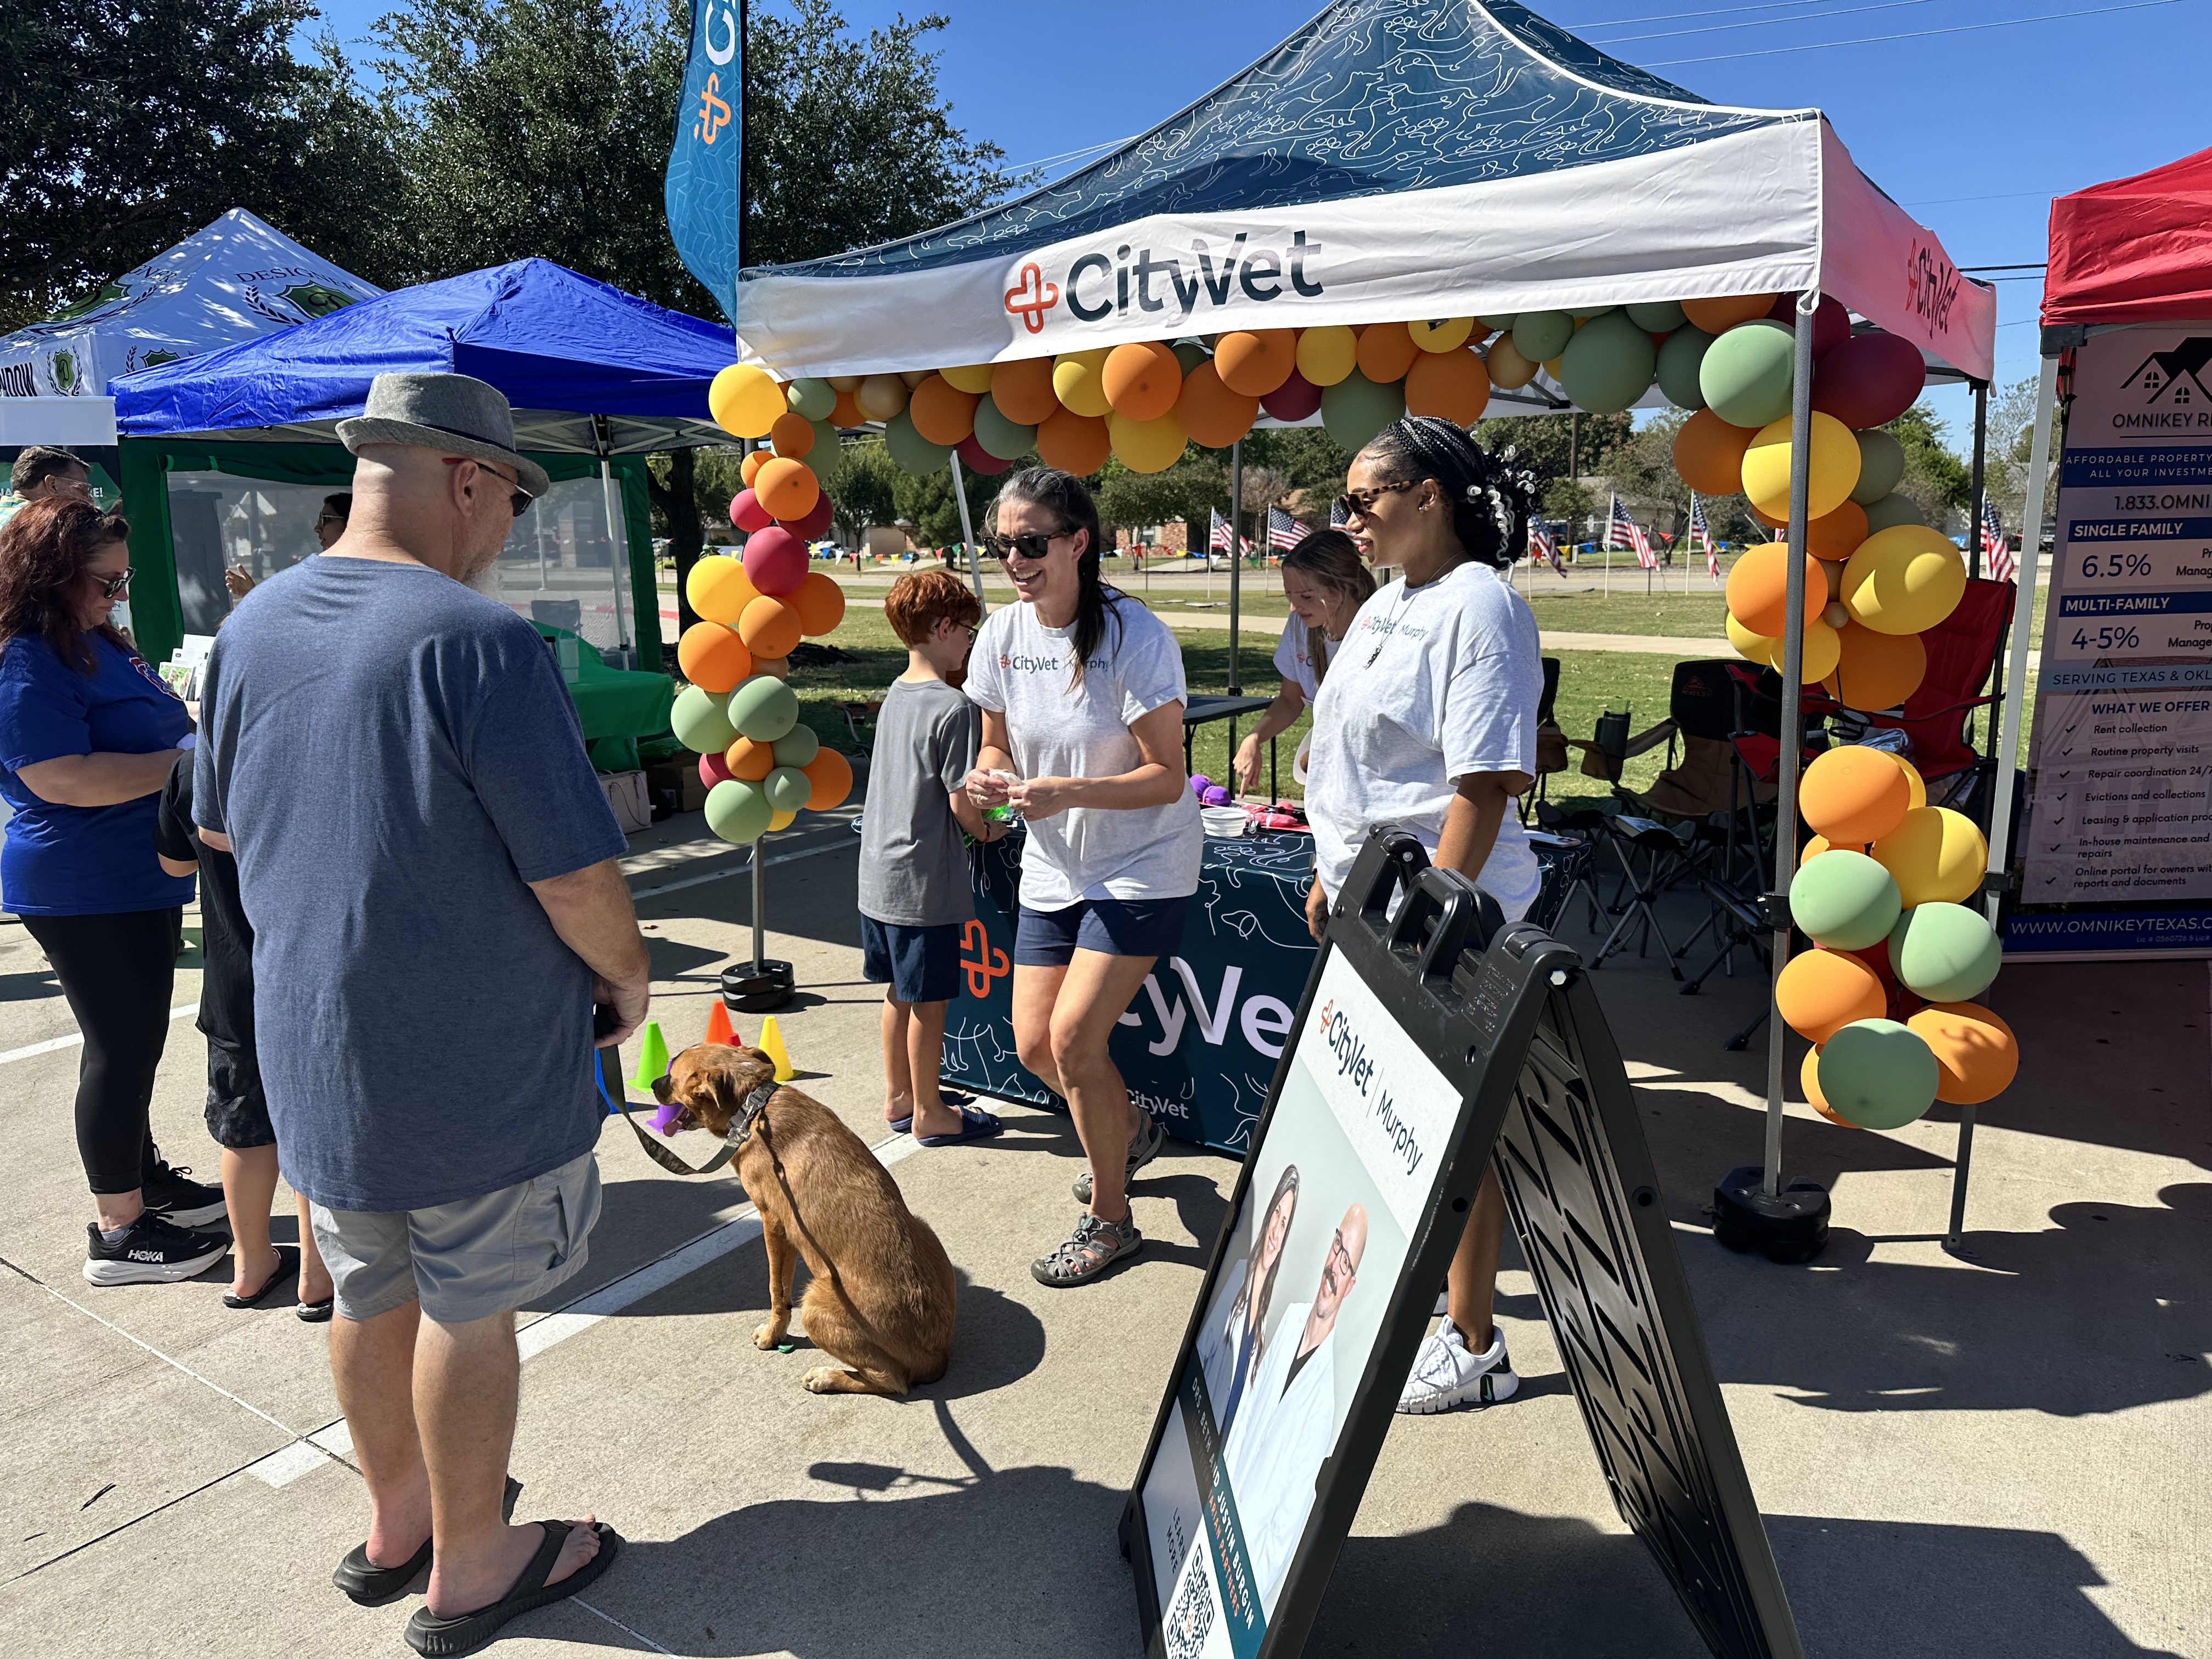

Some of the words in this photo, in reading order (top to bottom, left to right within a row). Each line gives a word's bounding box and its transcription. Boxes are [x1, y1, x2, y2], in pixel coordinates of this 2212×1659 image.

[1065, 230, 1324, 328] CityVet
[1917, 247, 1960, 340] CityVet
[2112, 413, 2193, 428] OMNIKEY
[2197, 413, 2212, 426] R
[2066, 454, 2145, 465] AFFORDABLE
[2089, 469, 2111, 478] ALL
[2117, 468, 2149, 477] YOUR
[2114, 494, 2212, 510] 1.833.OMNI
[2074, 523, 2126, 537] SINGLE
[2130, 522, 2183, 536] FAMILY
[2081, 552, 2152, 578] 6.5%
[2066, 596, 2170, 612] MULTI-FAMILY
[1401, 624, 1429, 641] Murphy
[2072, 625, 2140, 650] 4-5%
[1012, 655, 1059, 674] CityVet
[2053, 673, 2117, 685] SERVING
[2121, 671, 2165, 683] TEXAS
[2170, 670, 2179, 681] &
[2092, 702, 2135, 714] WHAT
[2140, 702, 2161, 713] WE
[2165, 701, 2210, 712] OFFER
[2094, 724, 2117, 734] Rent
[2119, 723, 2168, 733] collection
[2091, 747, 2128, 757] Routine
[2131, 746, 2174, 758] property
[2176, 744, 2199, 754] visits
[2088, 769, 2121, 780] Repair
[2123, 766, 2187, 778] coordination
[2085, 791, 2128, 802] Evictions
[2130, 790, 2151, 800] and
[2153, 789, 2206, 799] collections
[2083, 815, 2119, 827] Leasing
[2123, 815, 2130, 823] &
[2132, 812, 2189, 826] application
[2079, 837, 2121, 847] In-house
[2123, 835, 2188, 846] maintenance
[2191, 833, 2210, 843] and
[2078, 849, 2112, 860] repairs
[2075, 866, 2108, 876] Online
[2110, 865, 2141, 878] portal
[2143, 864, 2158, 874] for
[2073, 877, 2109, 888] reports
[2112, 876, 2132, 887] and
[2134, 874, 2186, 887] documents
[1329, 1011, 1374, 1097] CityVet
[1376, 1089, 1423, 1175] Murphy
[127, 1249, 163, 1262] HOKA
[1192, 1376, 1202, 1414] DRS.
[1200, 1411, 1212, 1453] BETH
[1209, 1453, 1220, 1488] AND
[1217, 1491, 1235, 1553] JUSTIN
[1232, 1550, 1254, 1630] BURGIN
[1173, 1506, 1186, 1562] LEARN
[1166, 1525, 1178, 1575] MORE
[1219, 1538, 1240, 1617] PARTNERS
